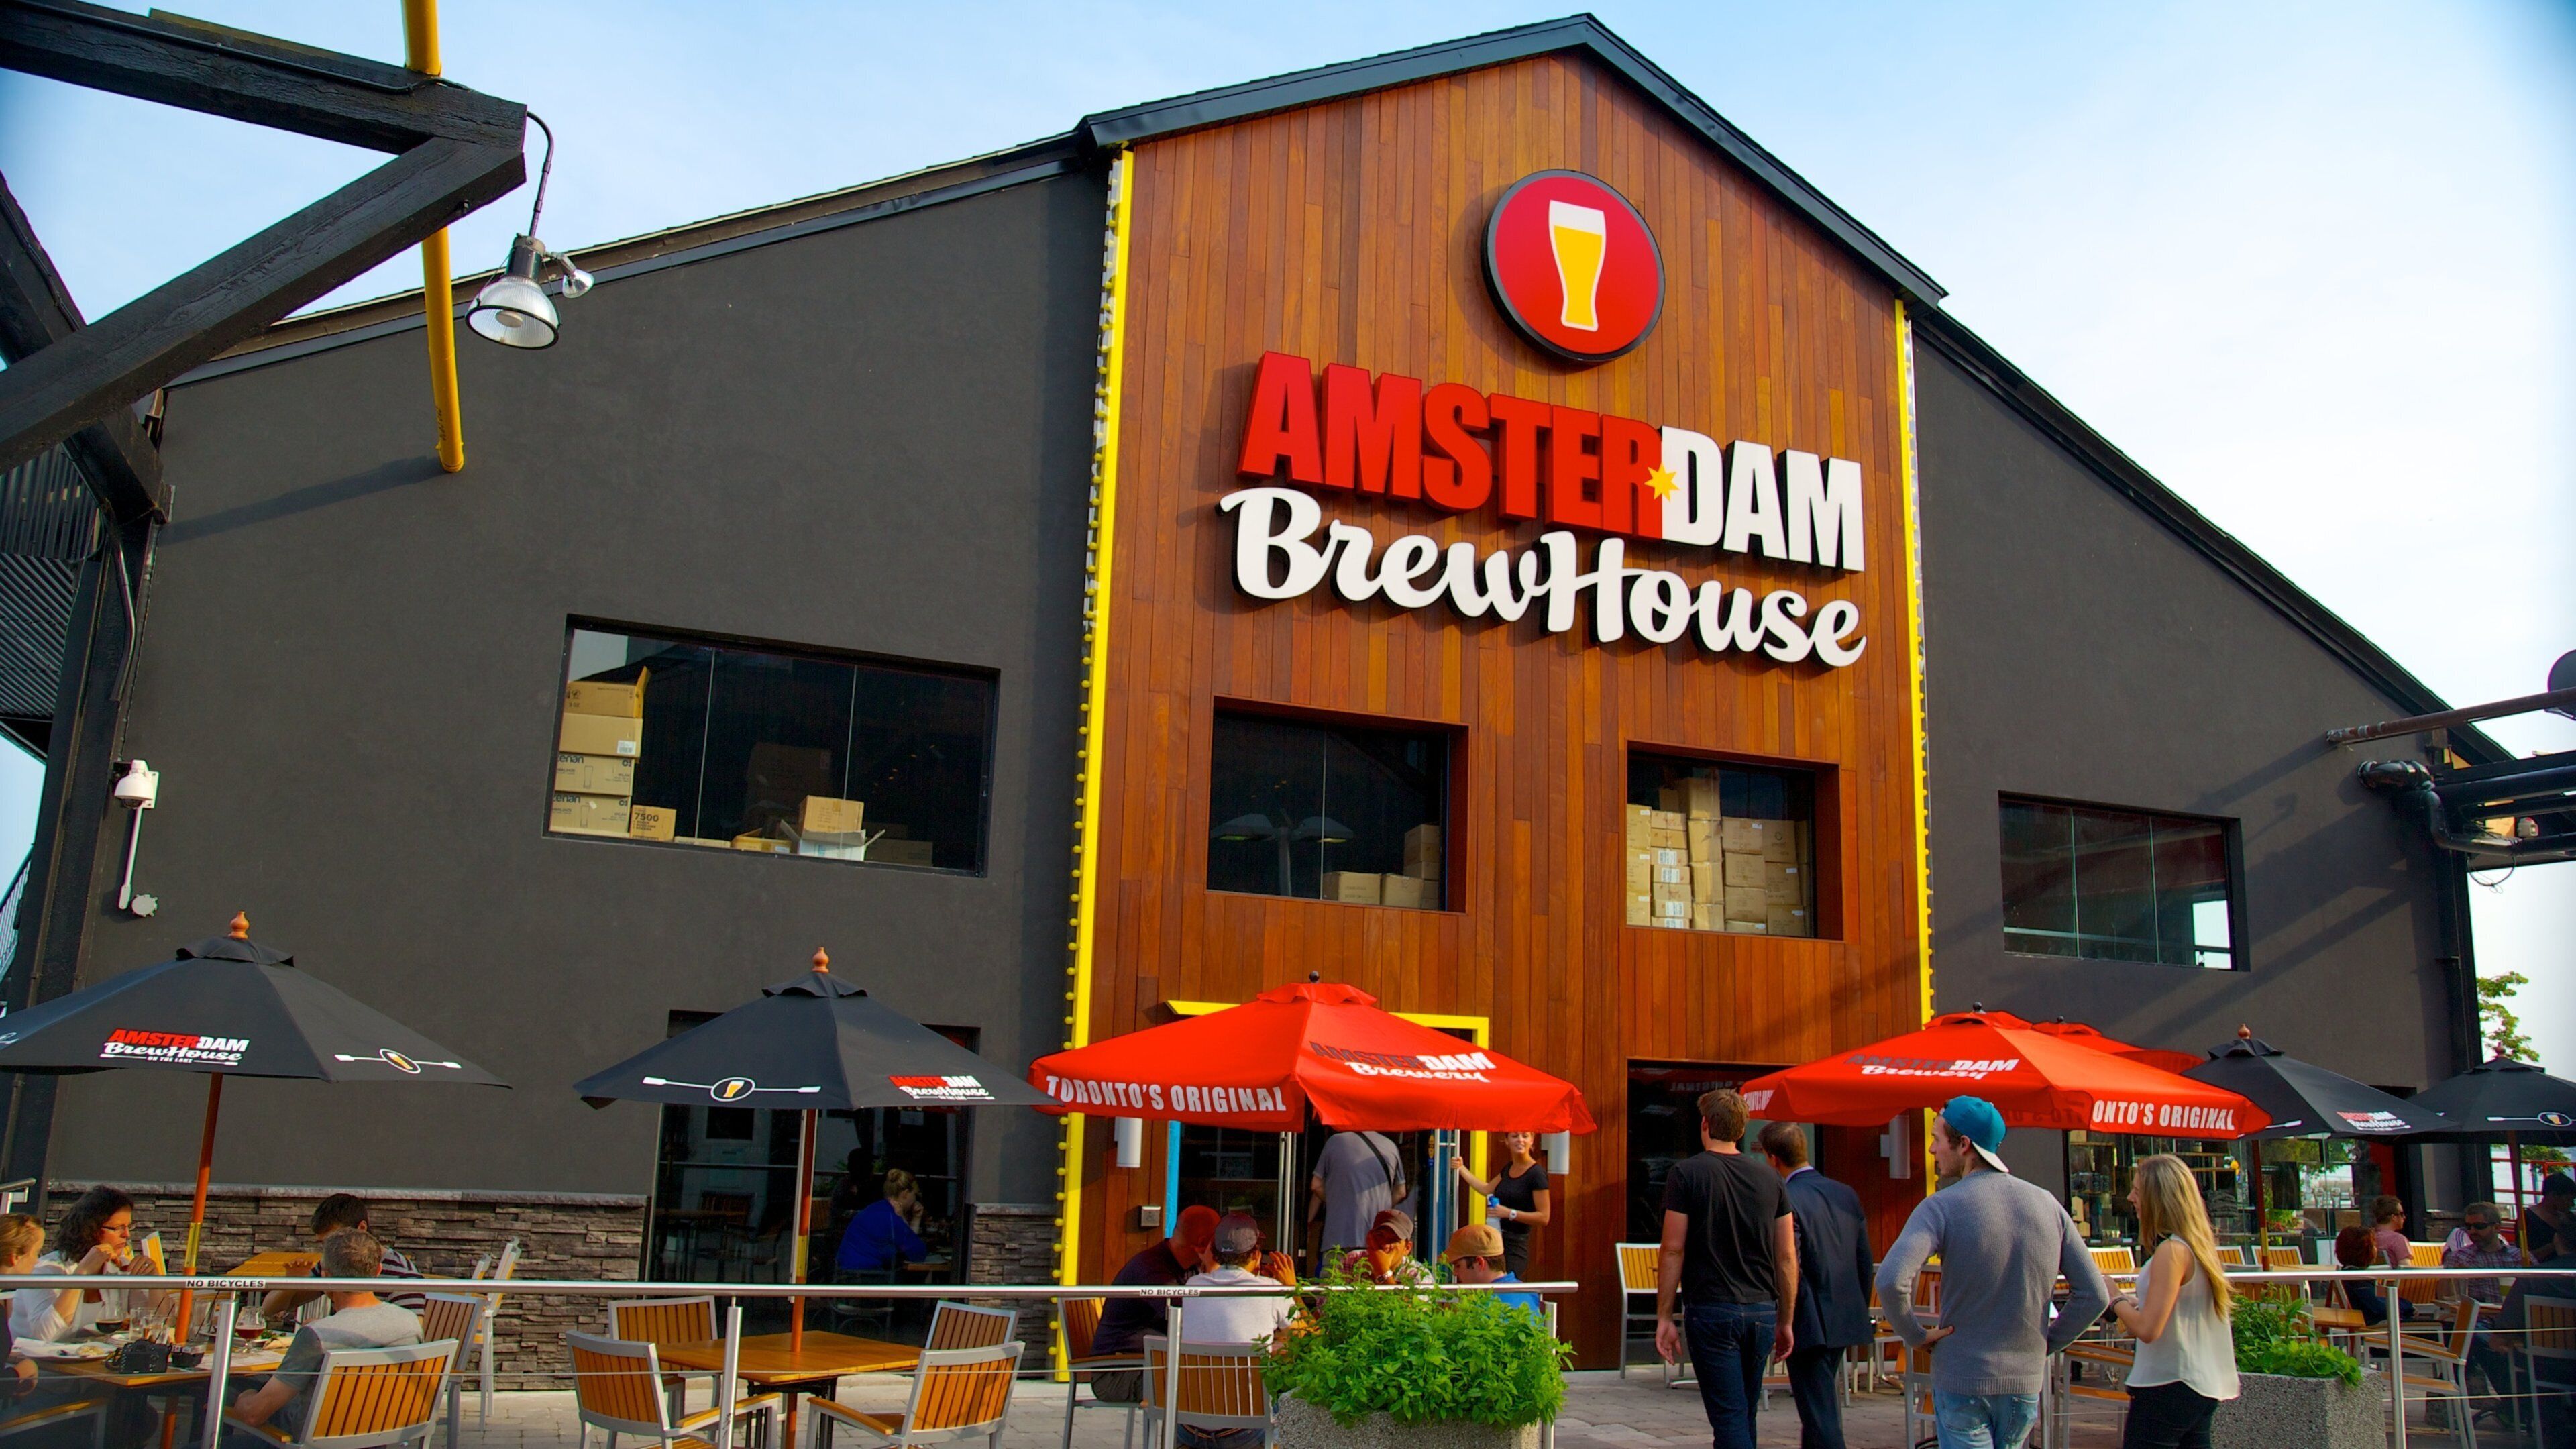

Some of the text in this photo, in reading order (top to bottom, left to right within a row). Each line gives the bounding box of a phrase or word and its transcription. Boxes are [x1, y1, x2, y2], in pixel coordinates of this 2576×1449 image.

[1236, 351, 1864, 573] AMSTERDAM
[1218, 487, 1866, 667] BrewHouse
[635, 812, 659, 822] 7500
[104, 1042, 242, 1061] BrewHouse
[107, 1029, 250, 1051] AMSTERDAM
[1309, 1041, 1496, 1070] AMSTERDAM
[1344, 1061, 1491, 1083] Brewery
[1046, 1075, 1287, 1112] TORONTO'S ORIGINAL
[2159, 1104, 2235, 1130] ORIGINAL
